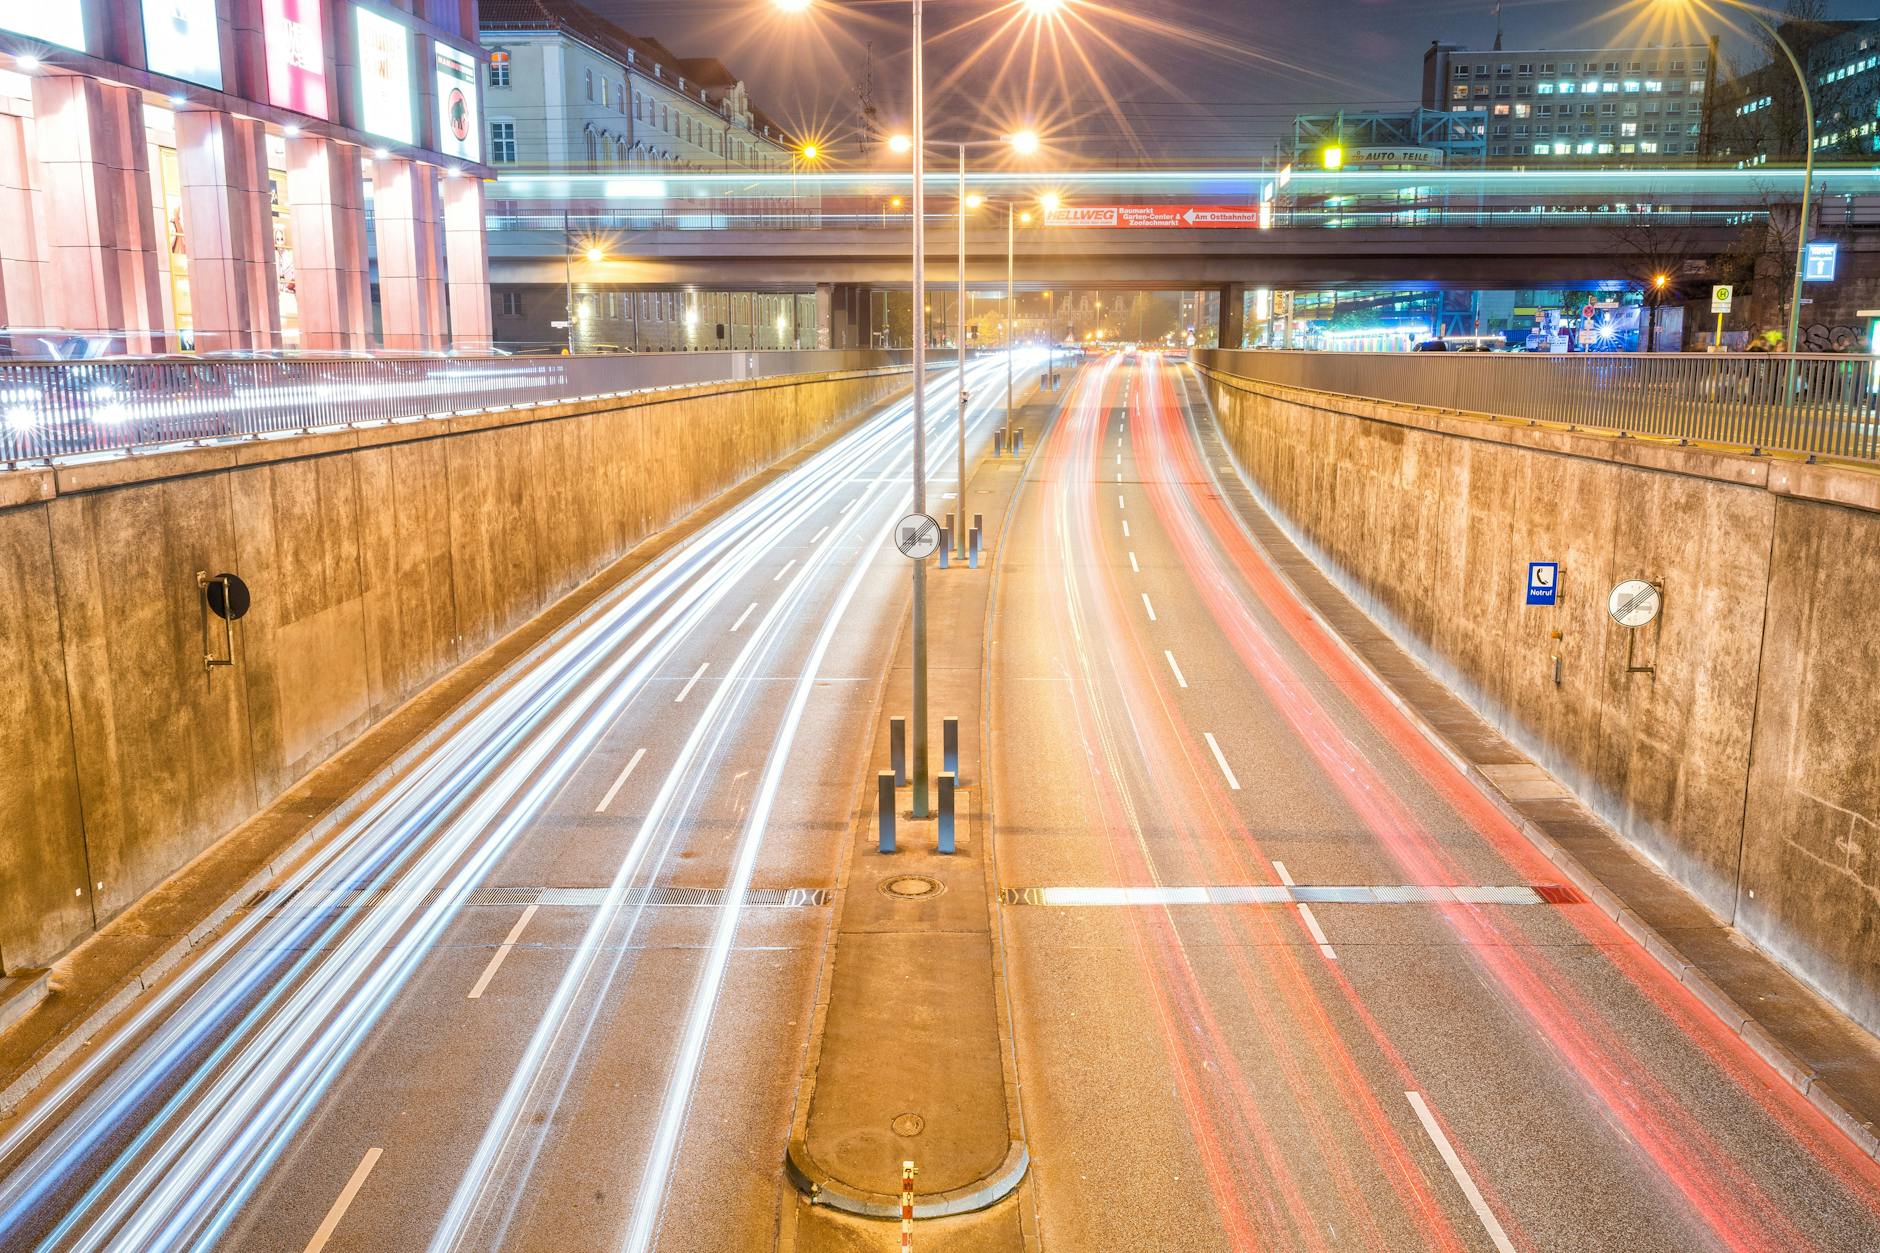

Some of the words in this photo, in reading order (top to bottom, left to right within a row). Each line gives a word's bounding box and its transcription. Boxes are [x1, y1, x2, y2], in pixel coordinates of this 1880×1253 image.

[1402, 152, 1428, 160] TEILE
[1046, 209, 1115, 220] HELLWEG
[1209, 213, 1255, 221] Ostbahnhof
